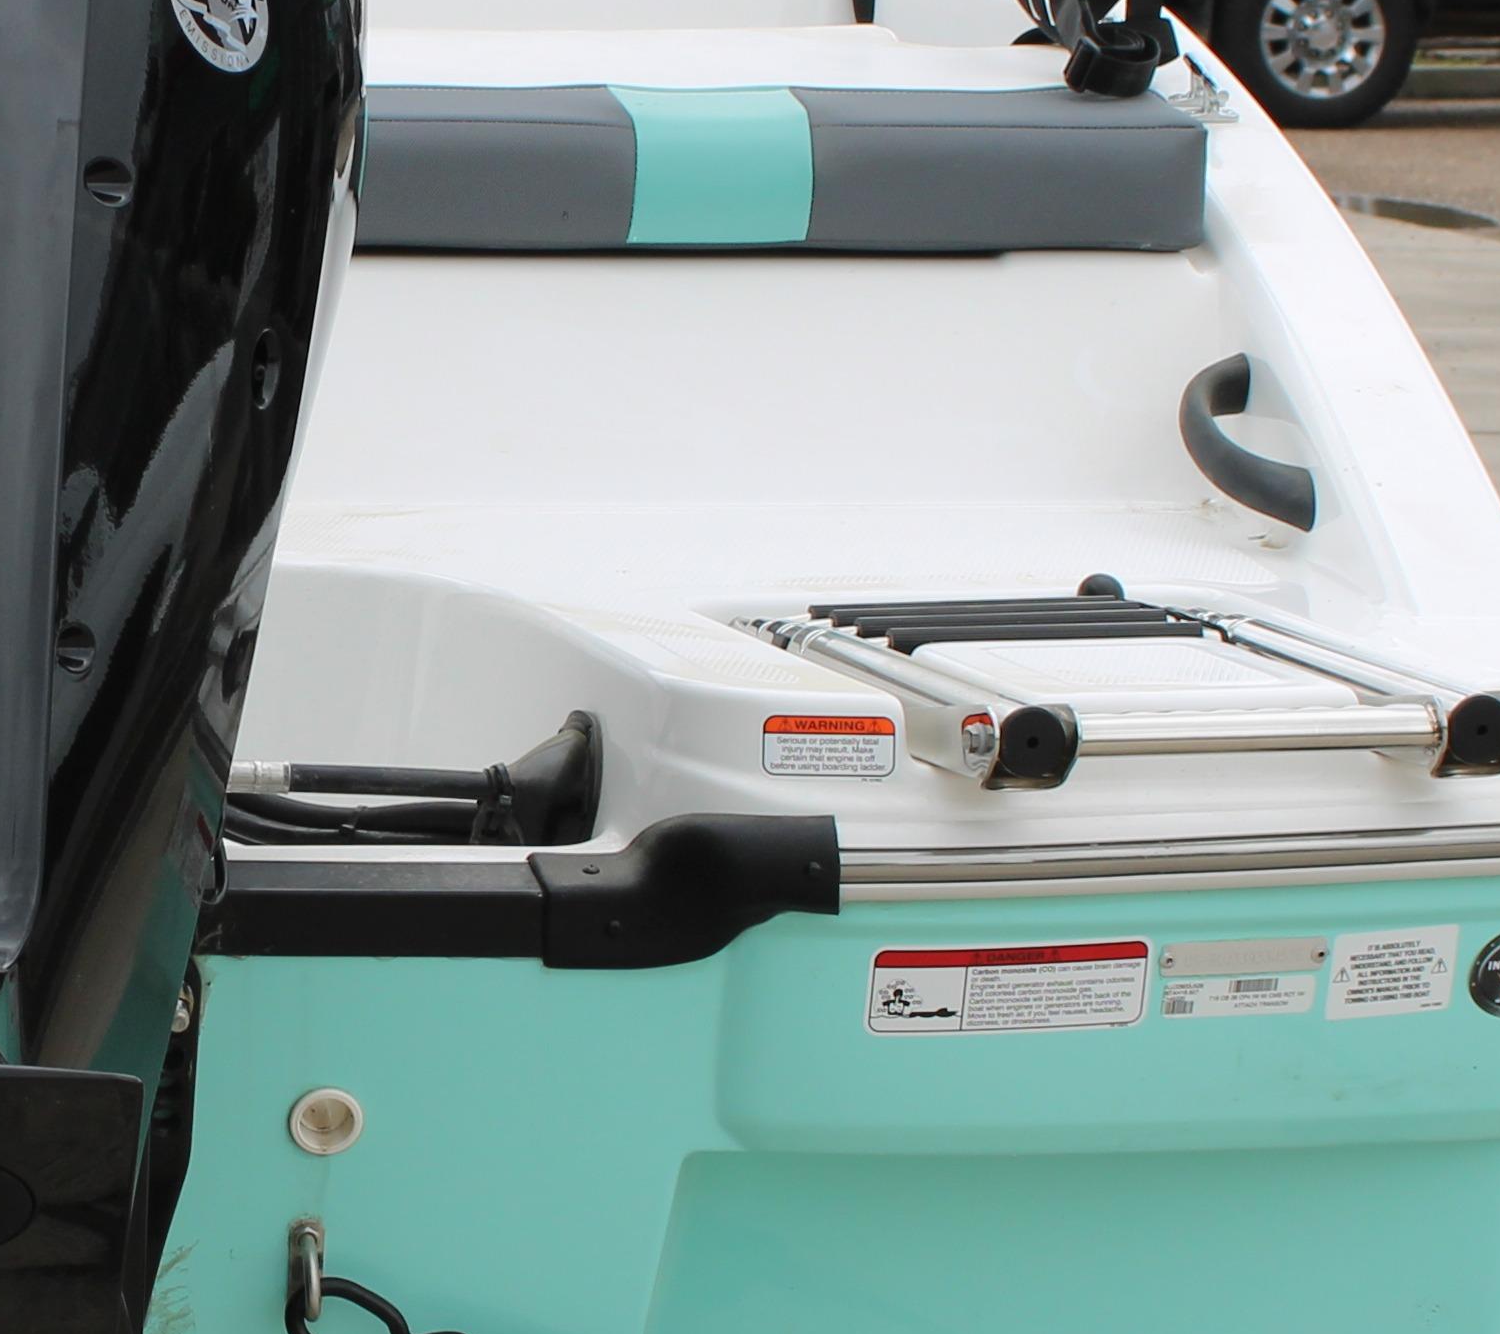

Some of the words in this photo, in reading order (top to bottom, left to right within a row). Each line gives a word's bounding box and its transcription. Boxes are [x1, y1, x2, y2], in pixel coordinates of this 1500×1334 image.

[179, 9, 247, 67] EMISSION
[794, 719, 866, 731] WARNING
[777, 737, 807, 745] Serious
[819, 737, 860, 747] potentially
[781, 746, 804, 755] injury
[805, 747, 823, 755] may
[827, 755, 854, 764] engine
[770, 762, 796, 770] before
[797, 763, 820, 772] using
[822, 763, 858, 773] boarding
[860, 763, 887, 771] ladder.
[1368, 943, 1375, 951] IT
[1382, 940, 1421, 949] ABSOLUTELY
[986, 951, 1045, 963] DANGER
[1350, 953, 1386, 961] NECESSARY
[1387, 951, 1403, 959] THAT
[1404, 949, 1417, 957] YOU
[1408, 956, 1434, 965] FOLLOW
[1113, 962, 1141, 971] damage
[1370, 967, 1411, 976] INFORMATION
[971, 983, 995, 991] Engine
[1012, 981, 1045, 989] generator
[1358, 977, 1402, 985] INSTRUCTIONS
[1347, 987, 1375, 995] OWNER'S
[1376, 985, 1401, 993] MANUAL
[1402, 983, 1422, 991] PRIOR
[1422, 981, 1432, 989] TO
[969, 997, 995, 1005] Carbon
[1345, 997, 1369, 1005] TOWING
[1370, 995, 1379, 1003] OR
[1380, 993, 1399, 1001] USING
[1400, 991, 1413, 999] THIS
[1413, 990, 1431, 999] BOAT
[1006, 1003, 1034, 1011] engines
[1044, 1001, 1081, 1009] generators
[1033, 1009, 1047, 1017] you
